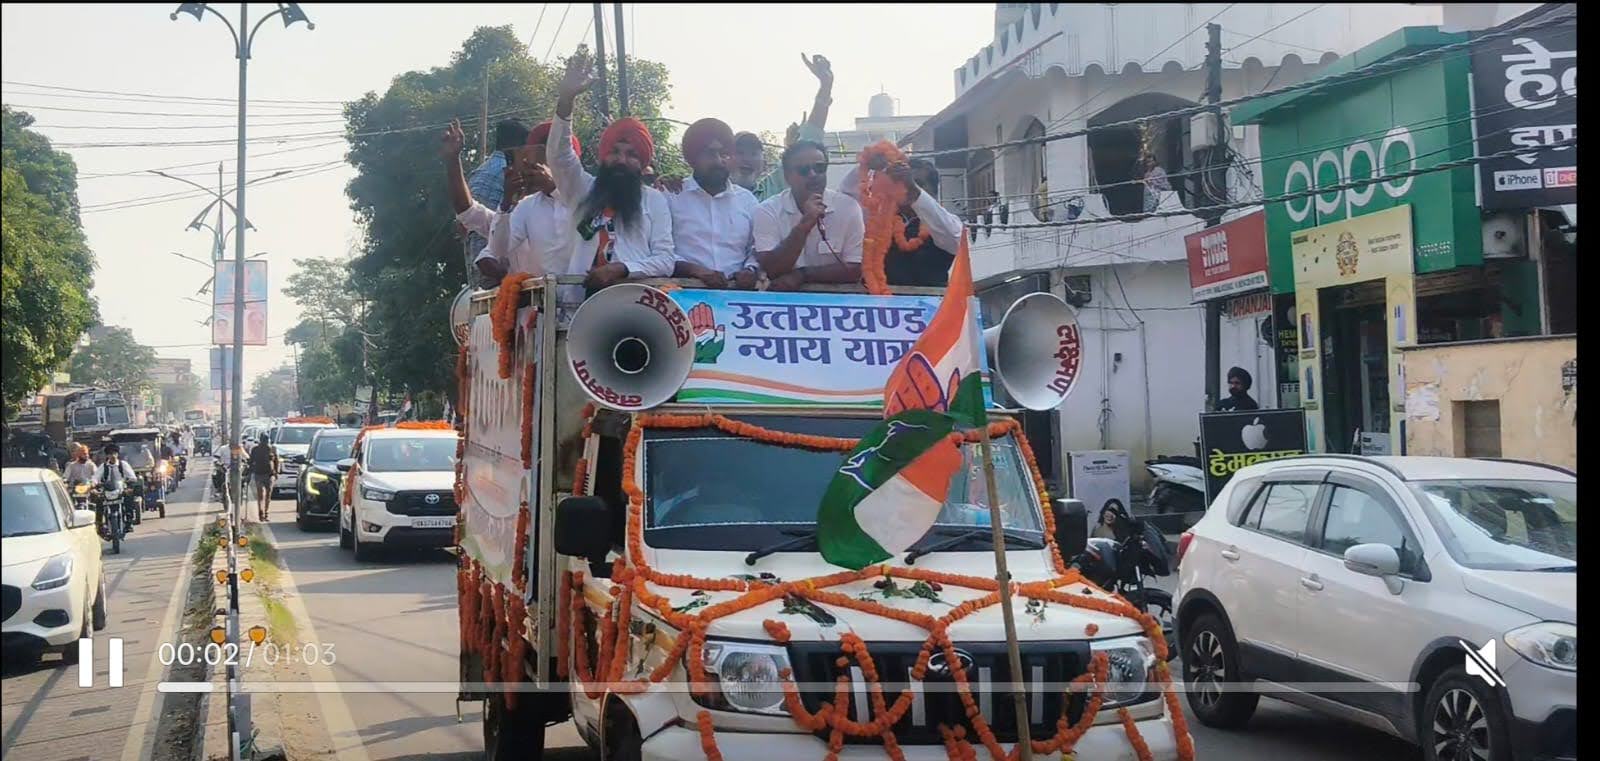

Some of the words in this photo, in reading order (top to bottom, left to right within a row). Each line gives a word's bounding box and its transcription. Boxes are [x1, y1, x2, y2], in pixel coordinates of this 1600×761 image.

[1502, 37, 1577, 110] हे
[1507, 174, 1539, 185] iPhone
[728, 302, 927, 334] उत्तराखण्ड
[736, 335, 831, 364] न्याय
[842, 338, 918, 366] यात्र
